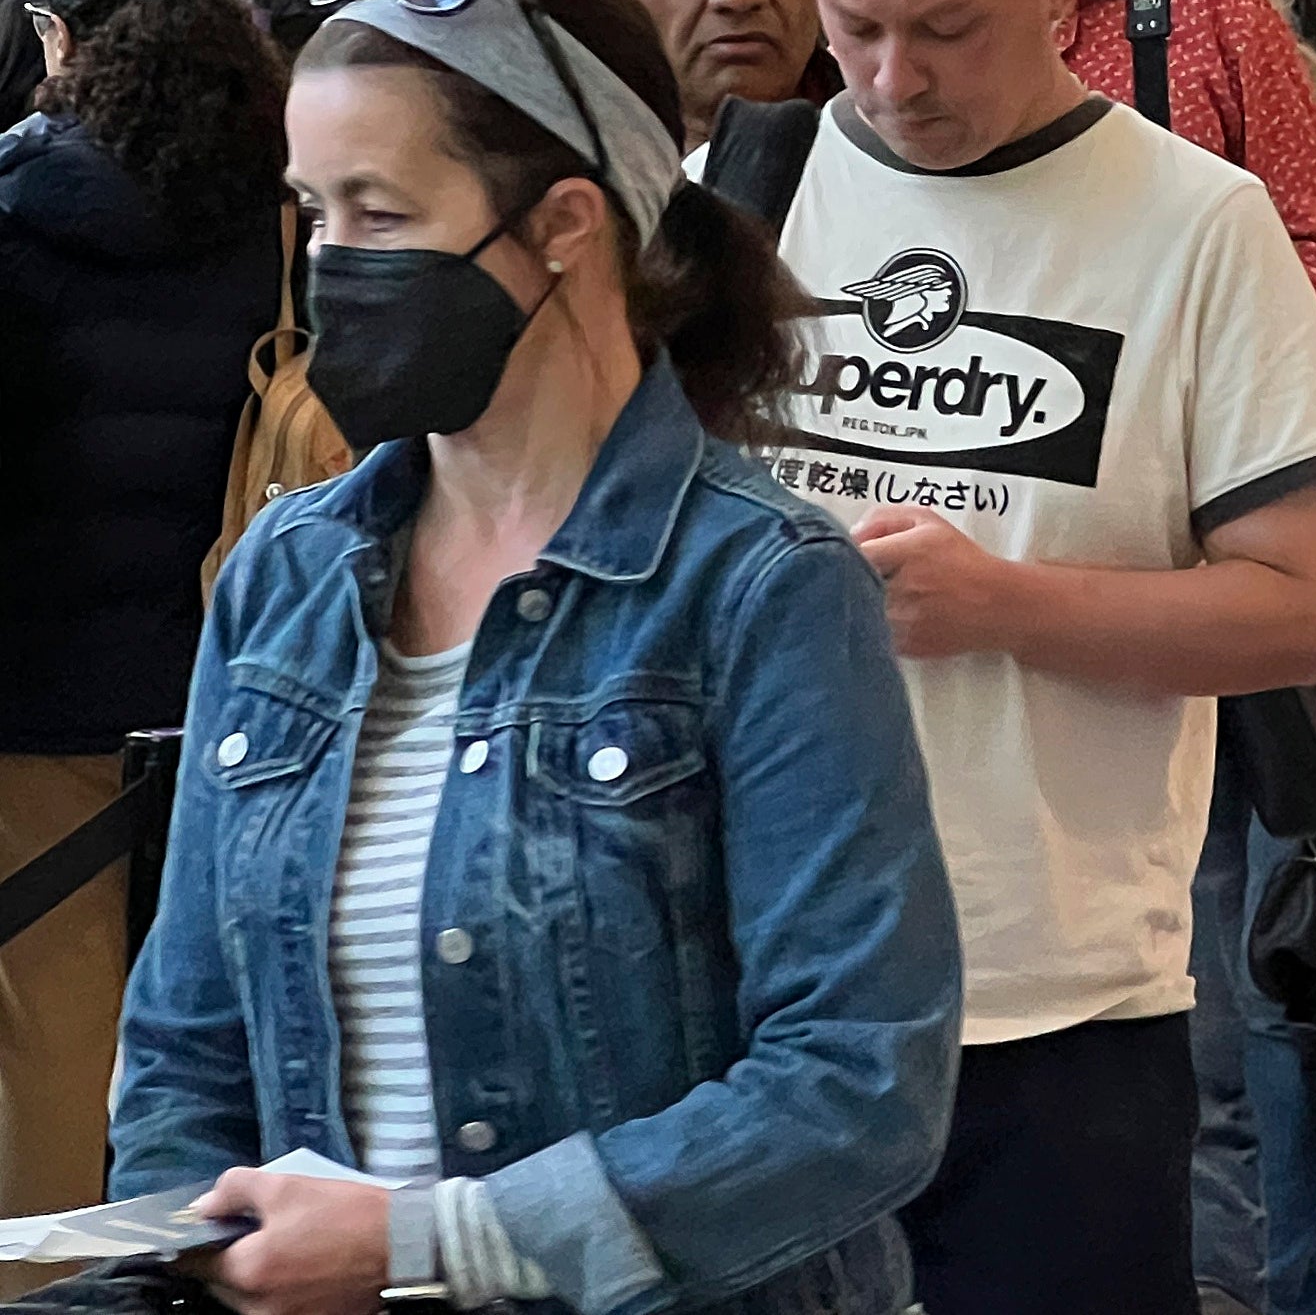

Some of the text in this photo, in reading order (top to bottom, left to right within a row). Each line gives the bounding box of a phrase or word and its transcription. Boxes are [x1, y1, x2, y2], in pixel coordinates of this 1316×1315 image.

[793, 353, 1048, 438] perdry.
[775, 457, 1010, 516] 度乾燥(しなさい)
